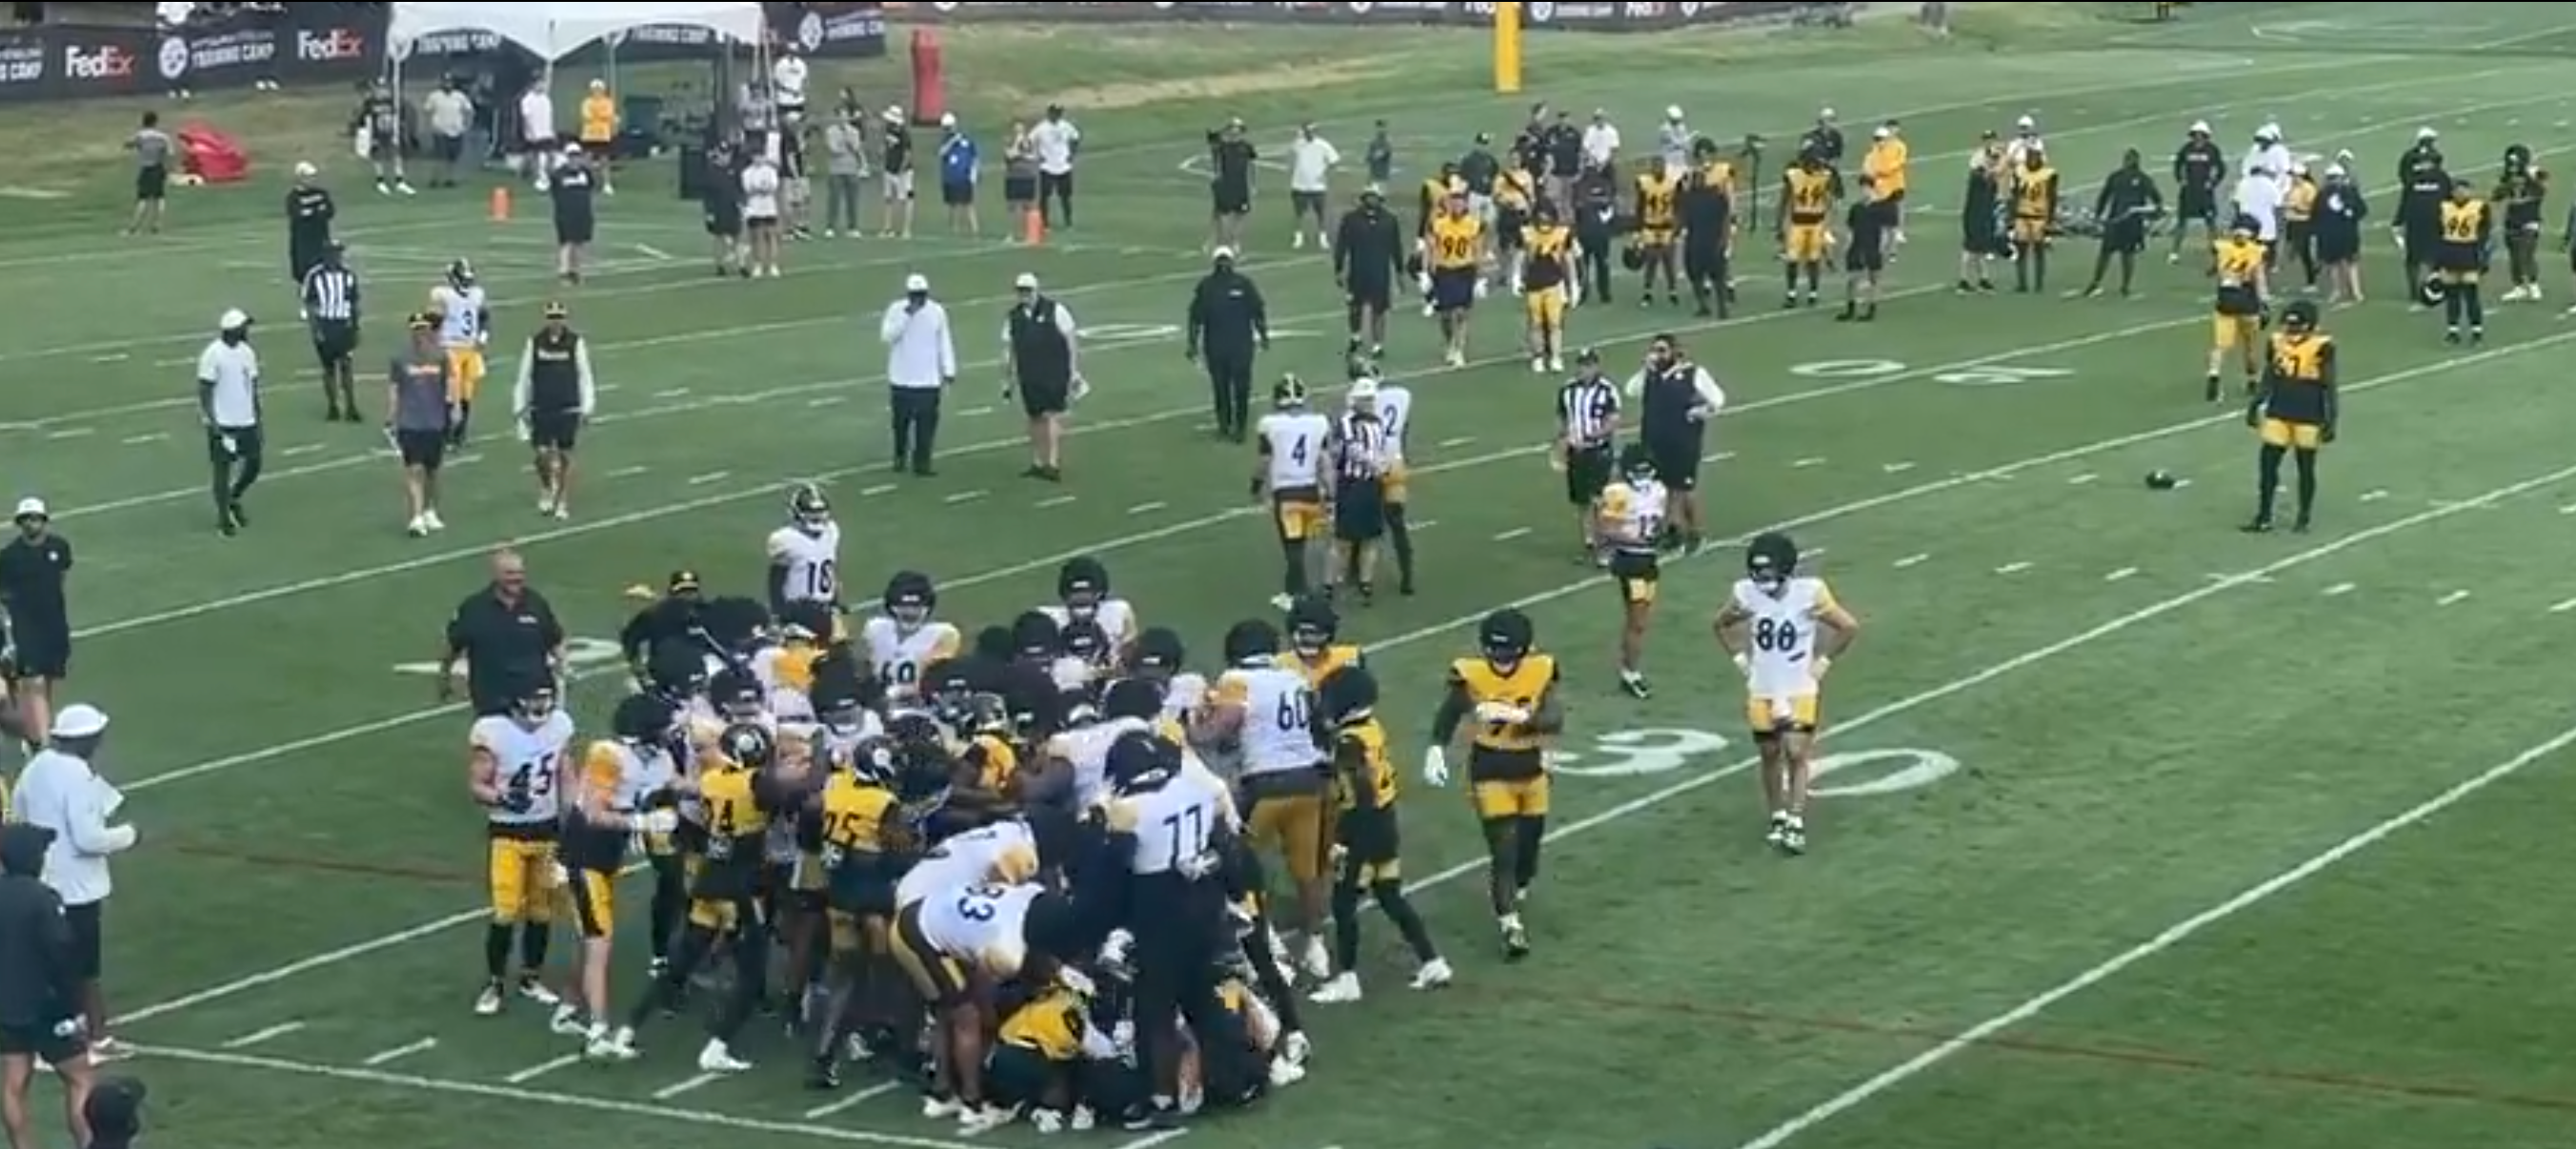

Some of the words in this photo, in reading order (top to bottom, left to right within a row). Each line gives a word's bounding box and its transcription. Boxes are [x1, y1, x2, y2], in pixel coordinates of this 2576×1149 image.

[65, 44, 134, 77] FedEx
[297, 30, 363, 59] FedEx
[1292, 433, 1306, 467] 4
[1278, 686, 1311, 732] 60
[1162, 802, 1202, 867] 77
